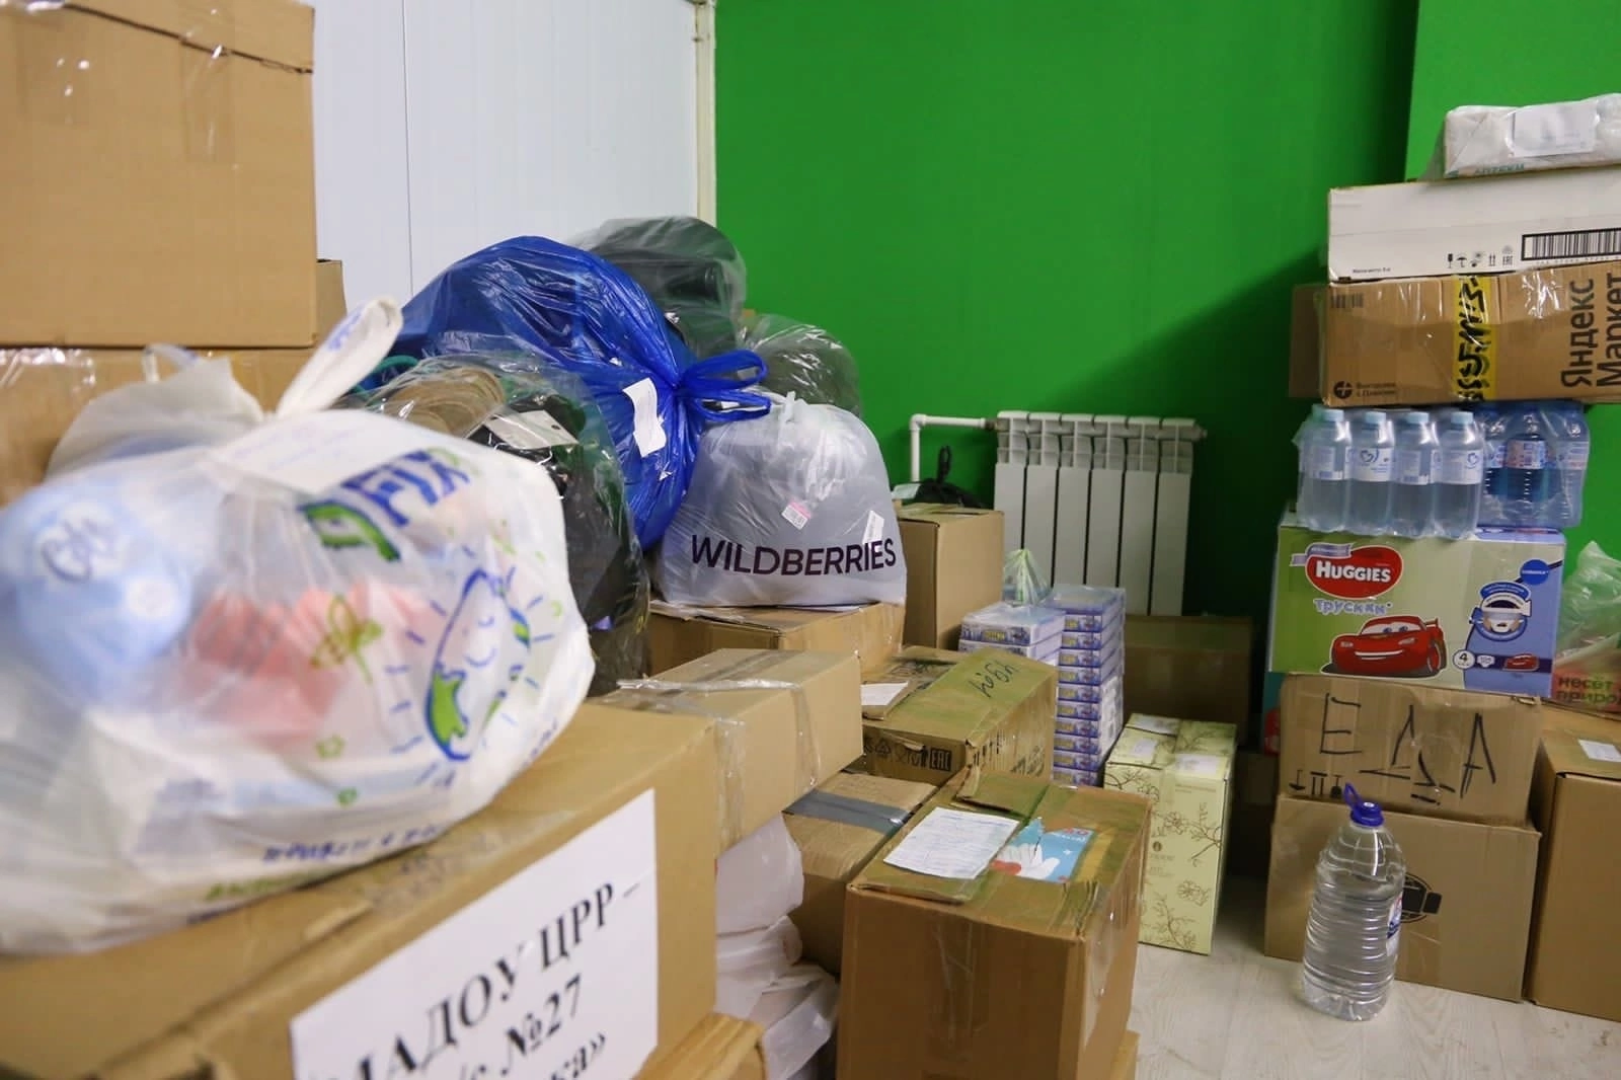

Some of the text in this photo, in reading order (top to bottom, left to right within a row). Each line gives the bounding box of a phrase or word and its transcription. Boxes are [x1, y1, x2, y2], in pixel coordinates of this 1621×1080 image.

[1561, 278, 1599, 387] Яндекс
[692, 534, 896, 576] WILDBERRIES
[1459, 652, 1468, 662] 4
[1319, 692, 1497, 805] ЕДА
[538, 882, 614, 971] ЦРР
[501, 973, 582, 1078] №27
